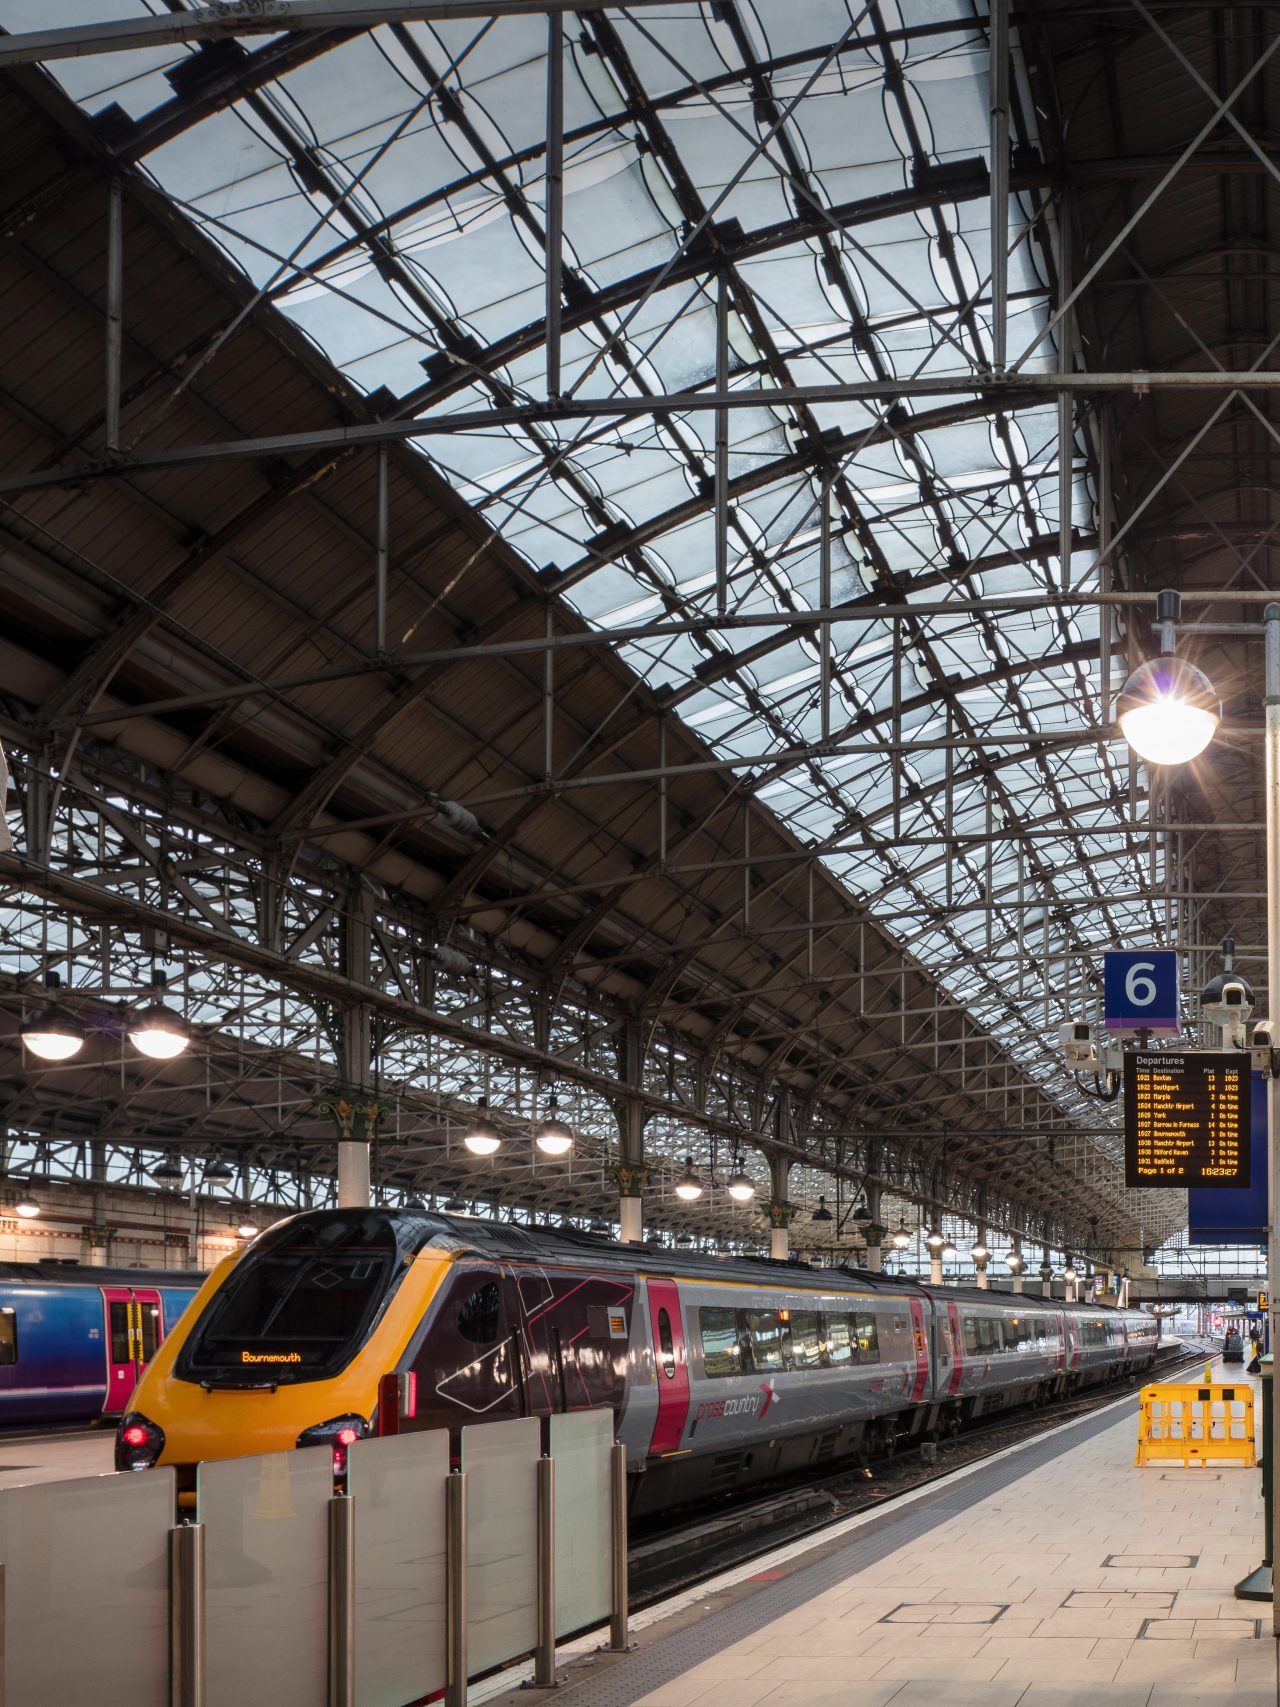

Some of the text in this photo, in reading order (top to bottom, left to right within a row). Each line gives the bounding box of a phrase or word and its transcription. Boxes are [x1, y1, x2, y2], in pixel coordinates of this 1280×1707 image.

[1125, 962, 1157, 1007] 6
[1136, 1057, 1184, 1065] Departures
[242, 1352, 301, 1363] Bournemouth
